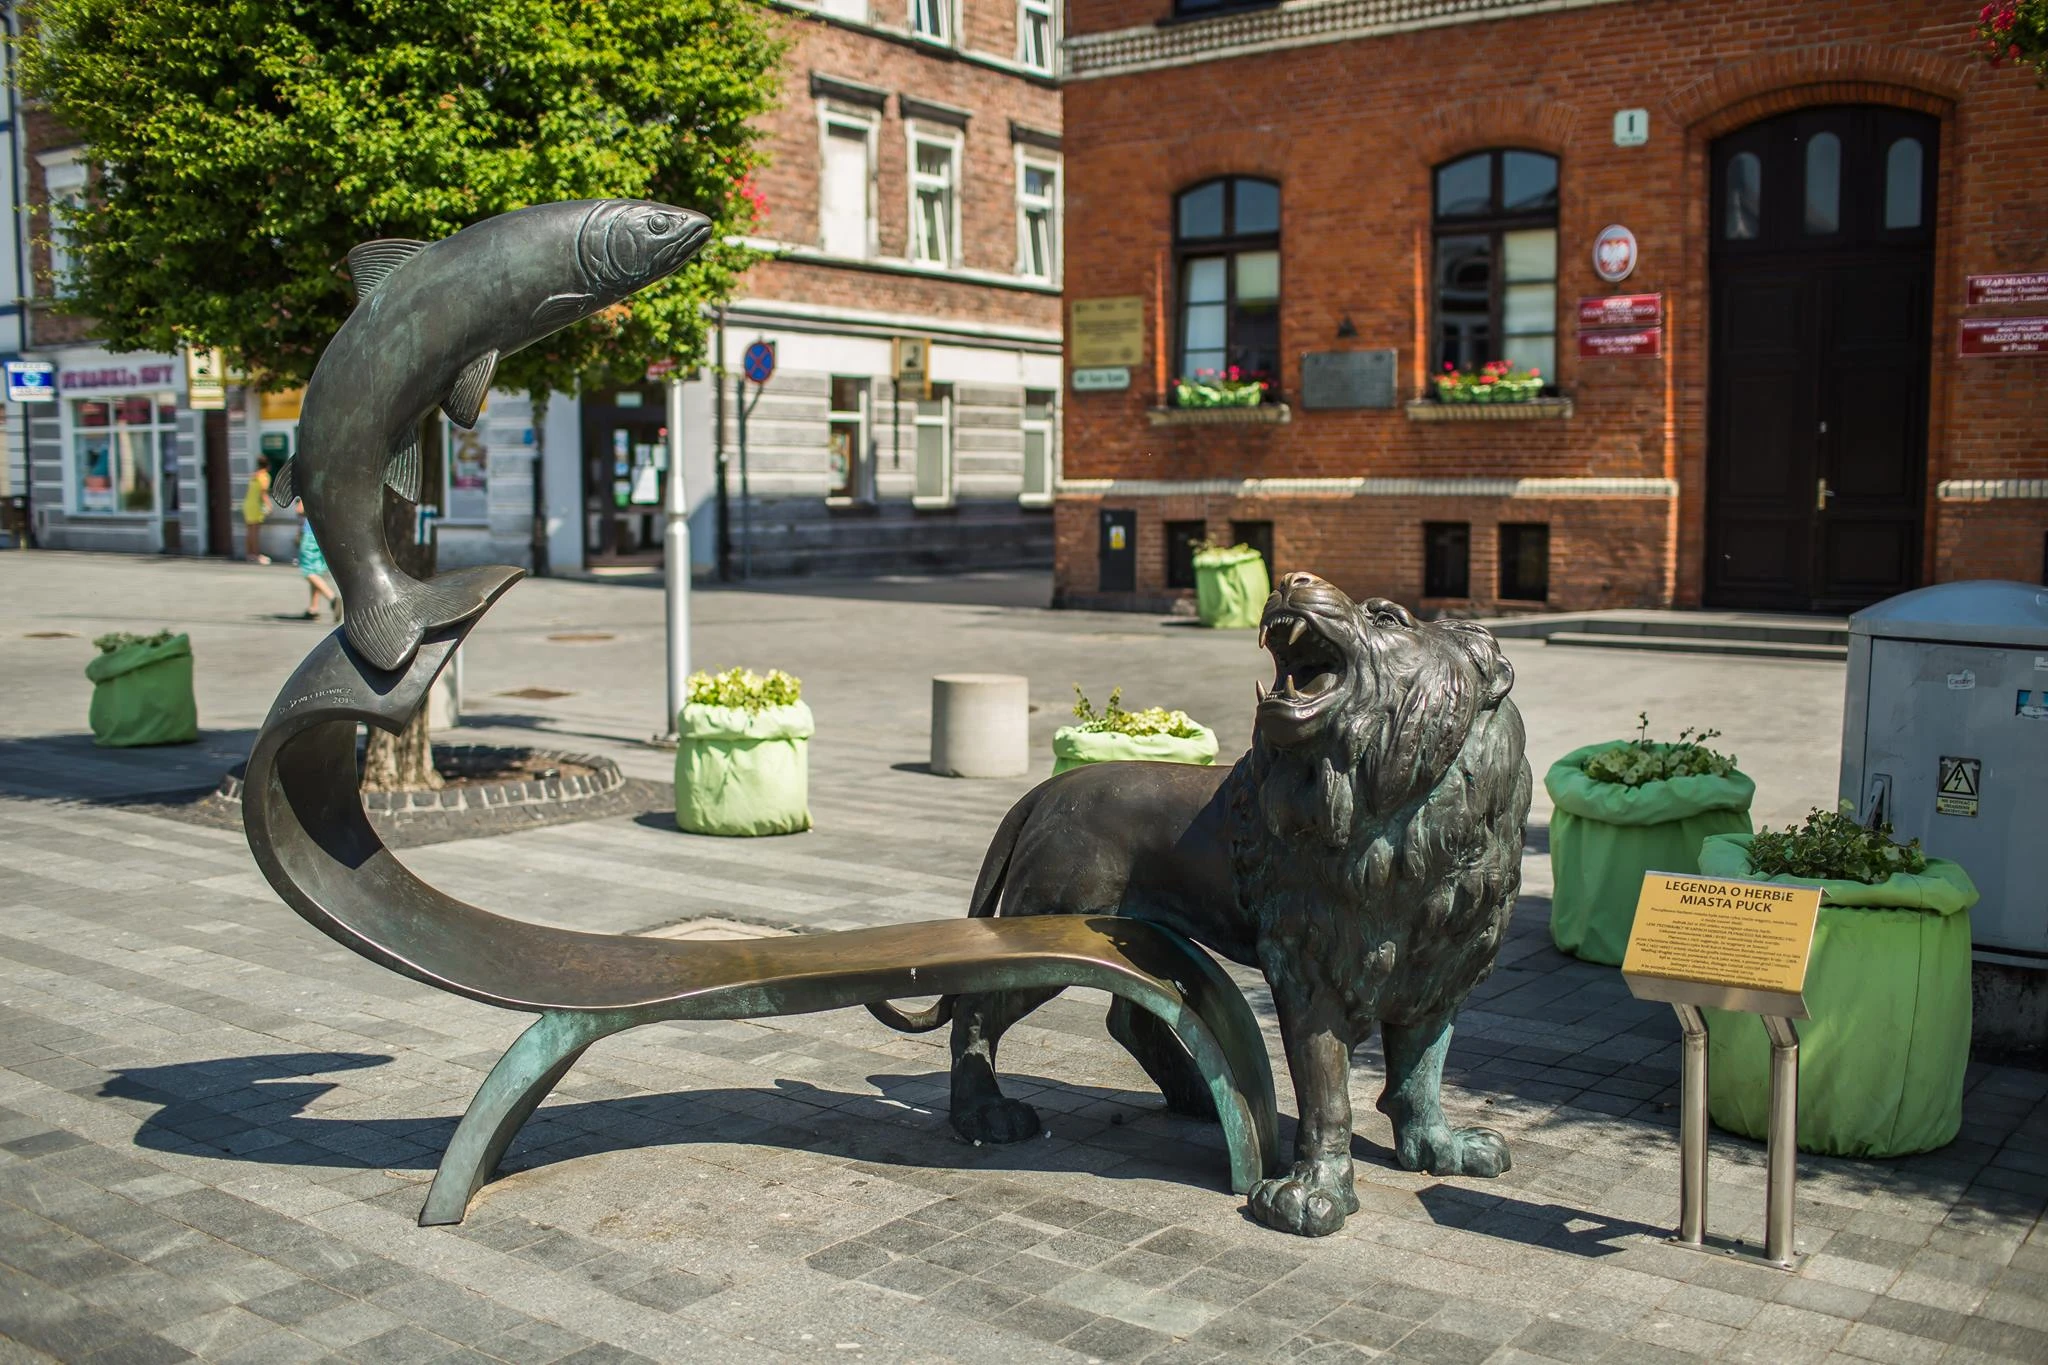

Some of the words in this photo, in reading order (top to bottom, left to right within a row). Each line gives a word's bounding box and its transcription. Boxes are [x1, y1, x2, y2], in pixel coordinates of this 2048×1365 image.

[2005, 277, 2036, 286] MIASTA
[1665, 880, 1727, 896] LEGENDA
[1730, 886, 1741, 897] O
[1744, 888, 1794, 902] HERBIE
[1680, 895, 1732, 909] MIASTA
[1736, 901, 1773, 913] PUCK
